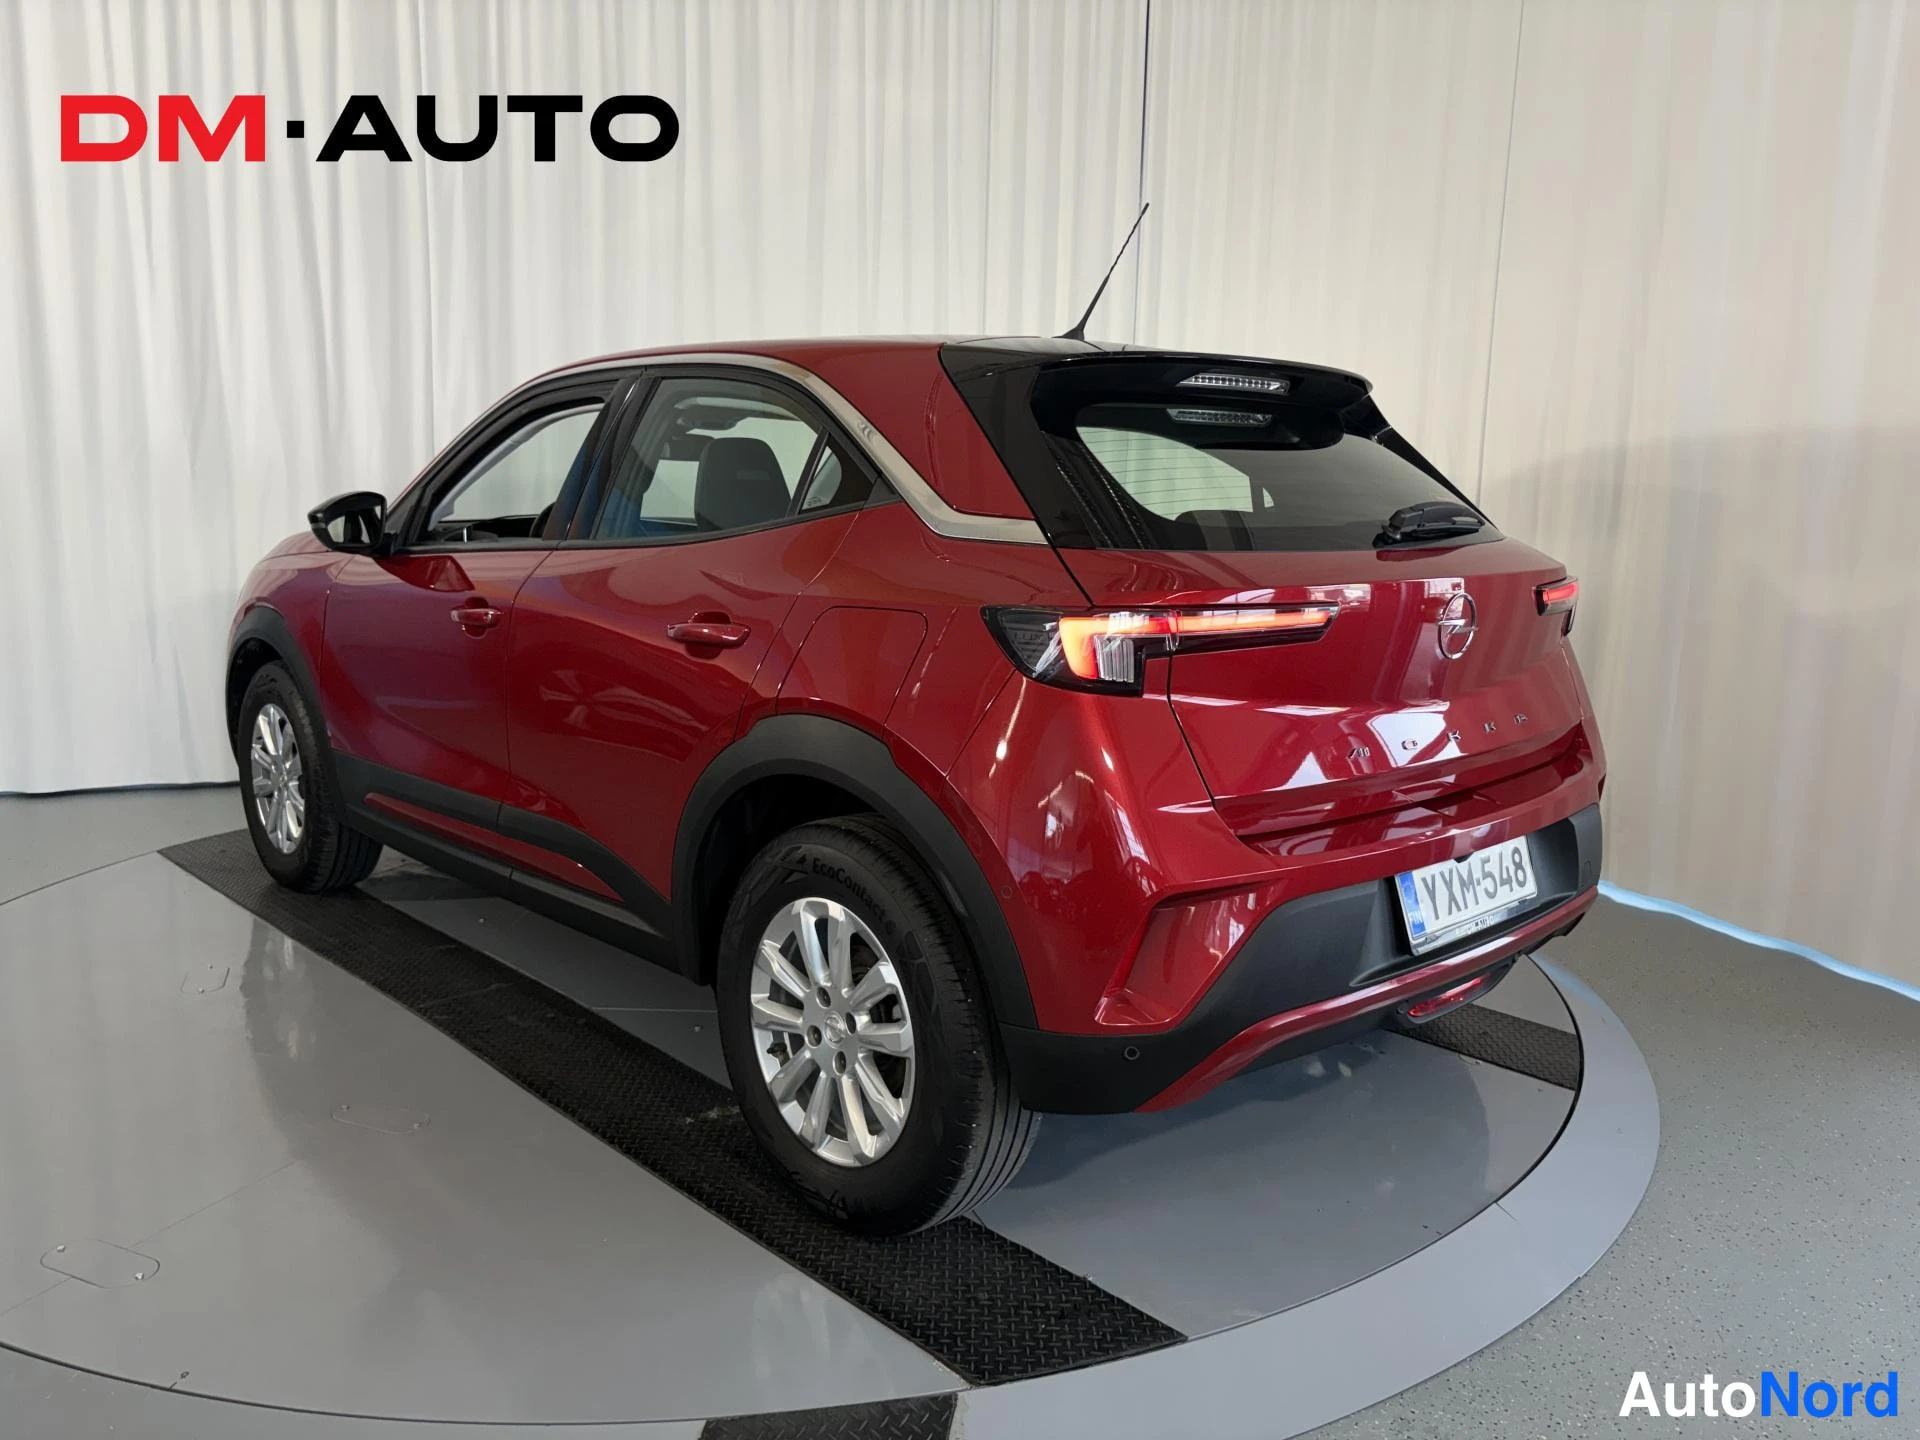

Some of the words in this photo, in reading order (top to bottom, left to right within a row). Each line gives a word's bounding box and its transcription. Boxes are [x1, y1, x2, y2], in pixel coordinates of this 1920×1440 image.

[812, 857, 886, 922] EcoContact
[1421, 846, 1527, 920] YXM-548
[1409, 911, 1423, 924] FIN
